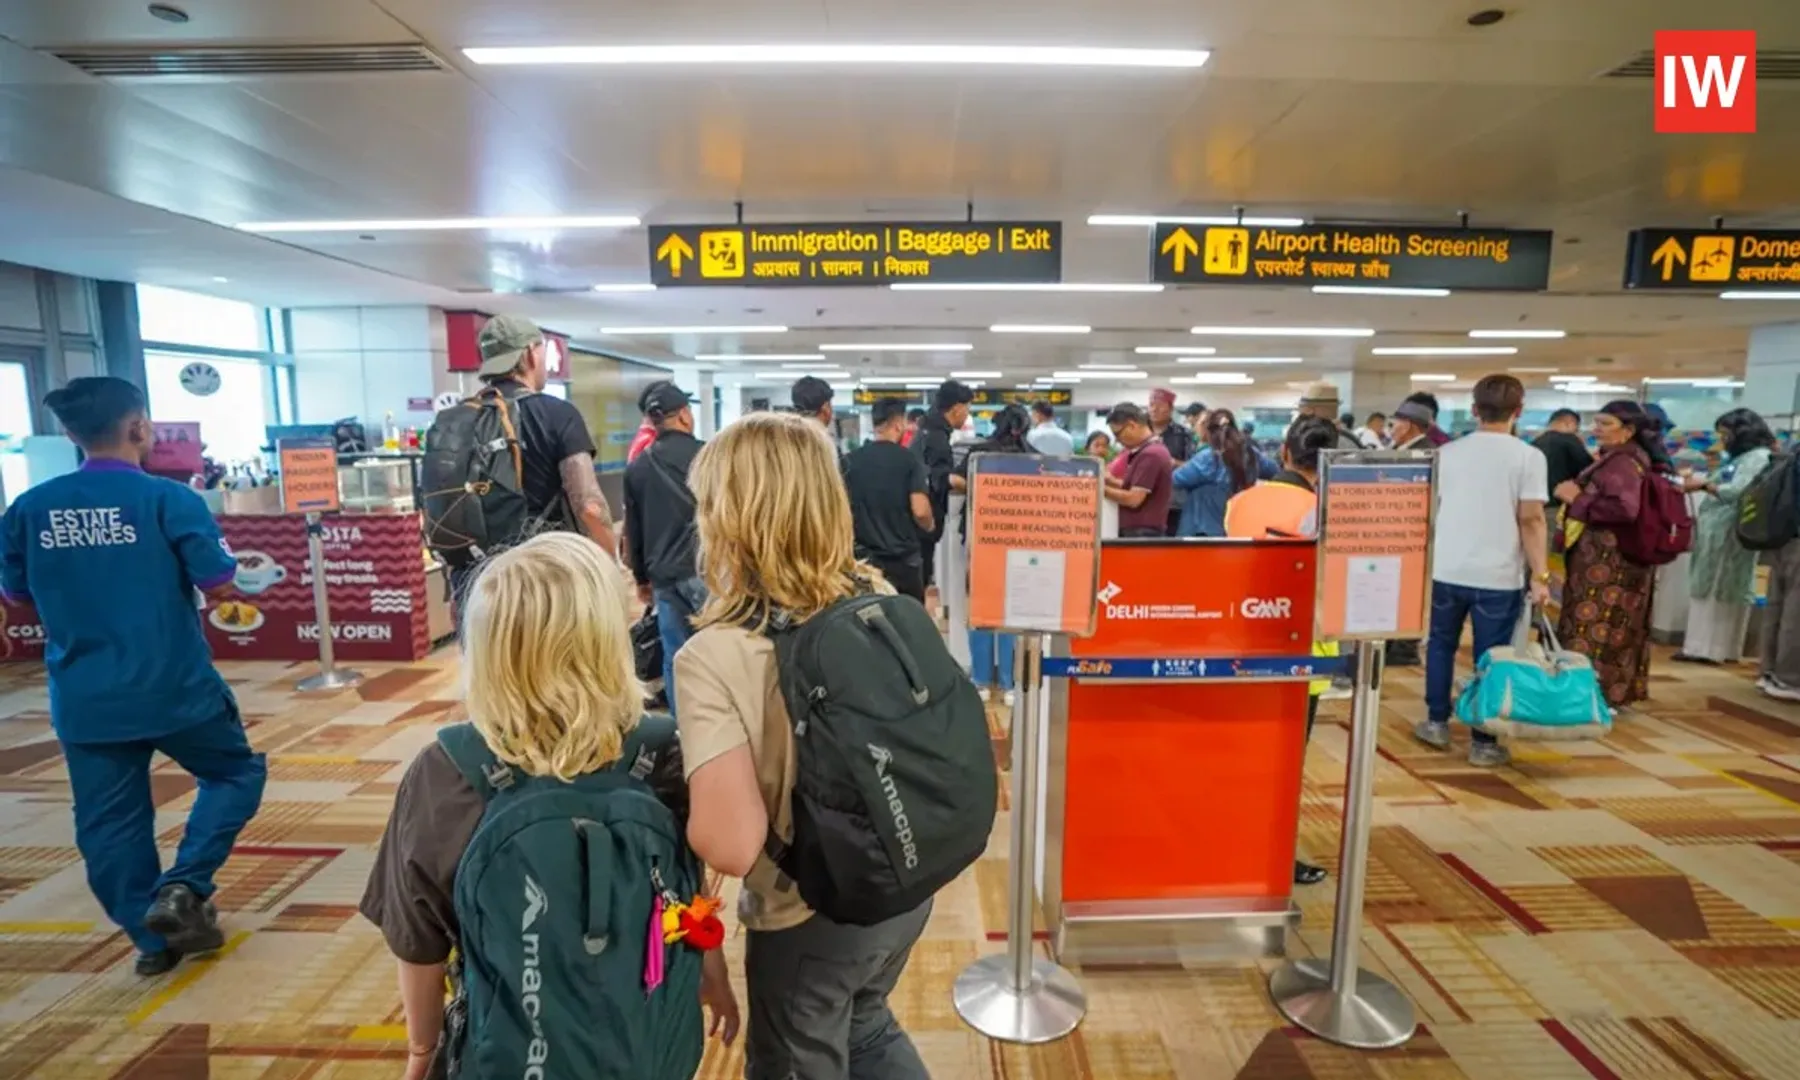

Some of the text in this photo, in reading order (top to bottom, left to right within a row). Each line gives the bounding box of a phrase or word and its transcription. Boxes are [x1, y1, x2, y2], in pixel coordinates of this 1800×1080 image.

[752, 228, 1051, 256] Immigration Baggage Exit
[1255, 230, 1509, 262] Airport Health Screening
[1741, 236, 1800, 258] Dome
[822, 261, 863, 276] सामान
[885, 256, 930, 276] निकास
[982, 477, 998, 487] ALL
[1035, 494, 1049, 503] TO
[1071, 496, 1089, 505] THE
[50, 507, 122, 530] ESTATE
[39, 525, 137, 549] SERVICES
[321, 527, 363, 541] OSTA
[1106, 605, 1148, 619] DELHI
[343, 624, 392, 641] OPEN
[881, 775, 919, 869] macpac
